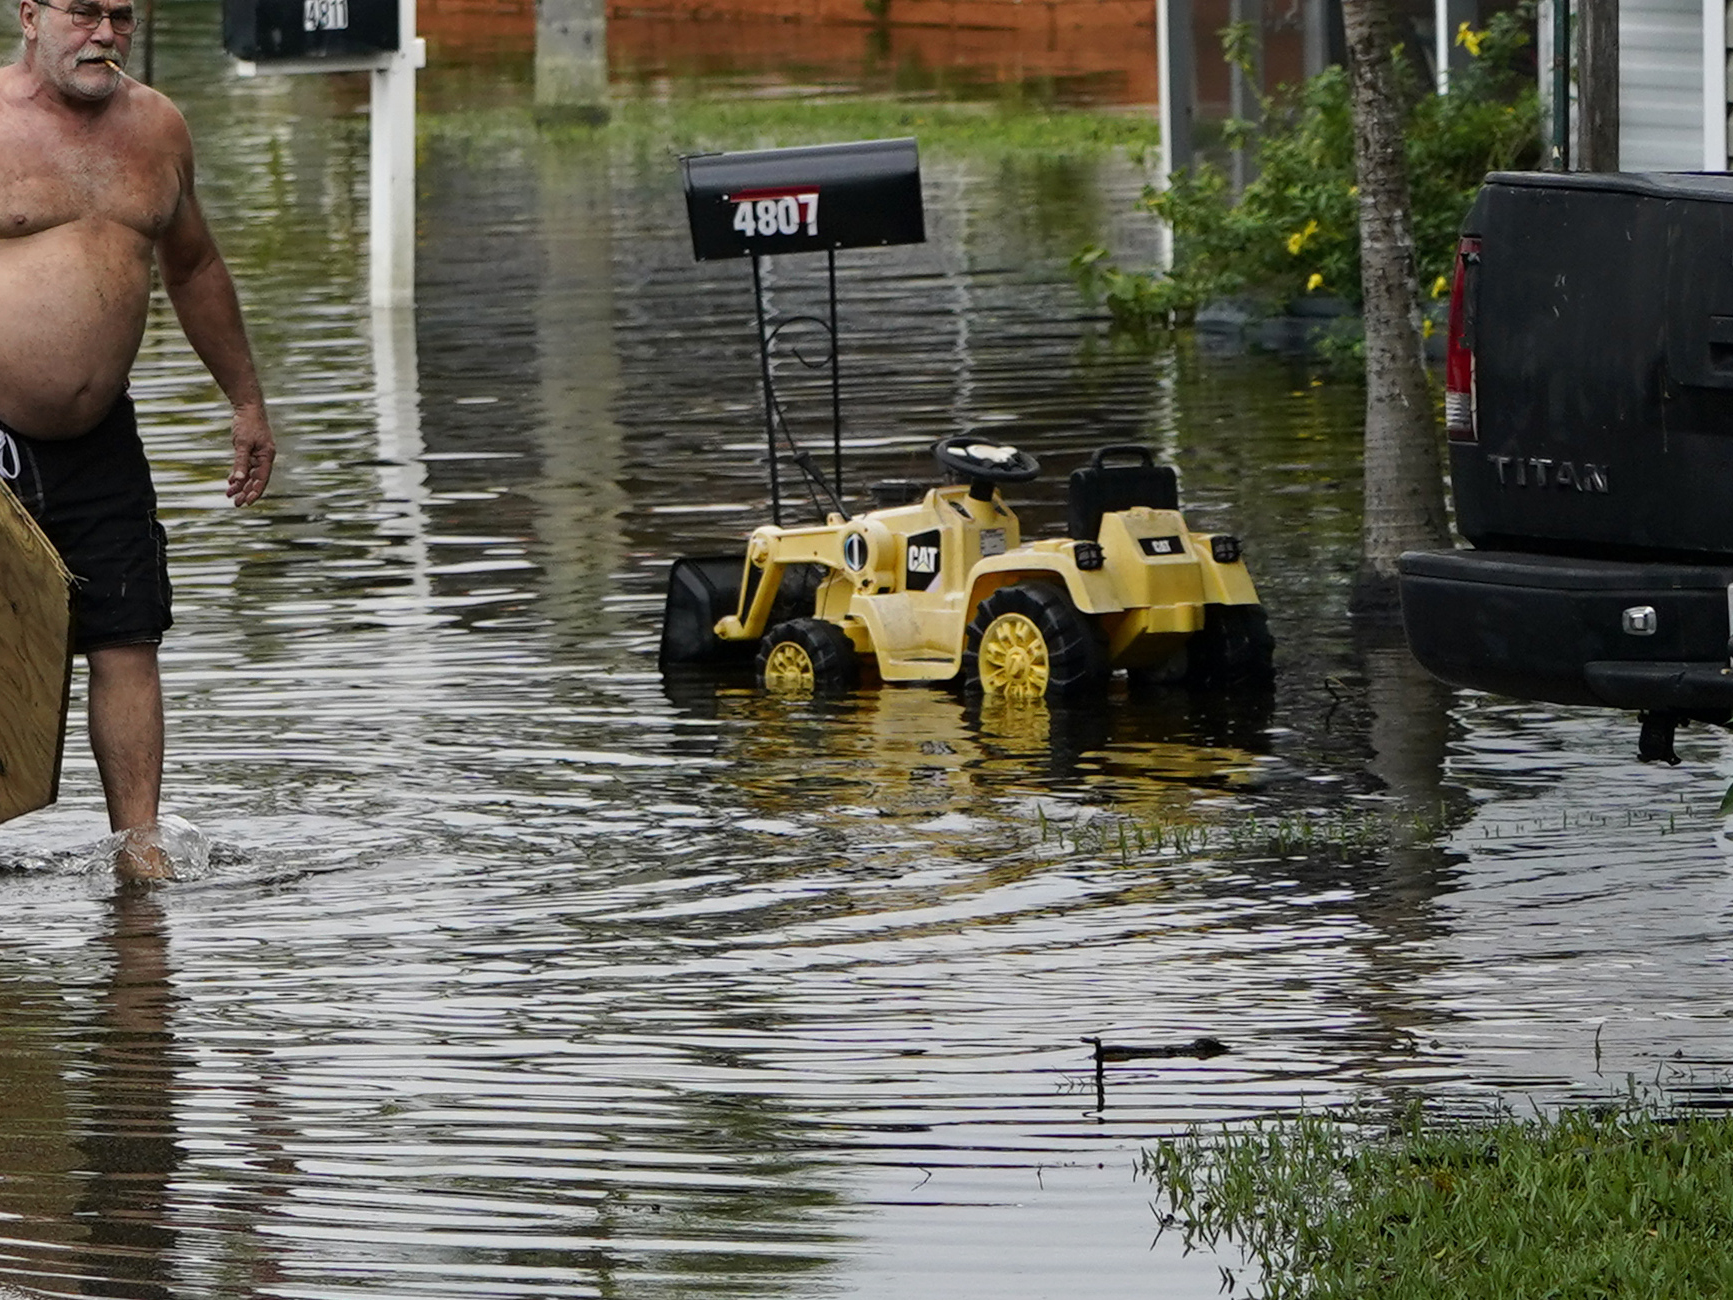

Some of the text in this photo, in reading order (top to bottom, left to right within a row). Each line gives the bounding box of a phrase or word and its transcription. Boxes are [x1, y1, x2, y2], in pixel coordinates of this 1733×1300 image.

[734, 194, 819, 237] 4807
[1487, 454, 1611, 494] TITAN
[908, 545, 939, 573] CAT
[1151, 540, 1172, 553] CAT
